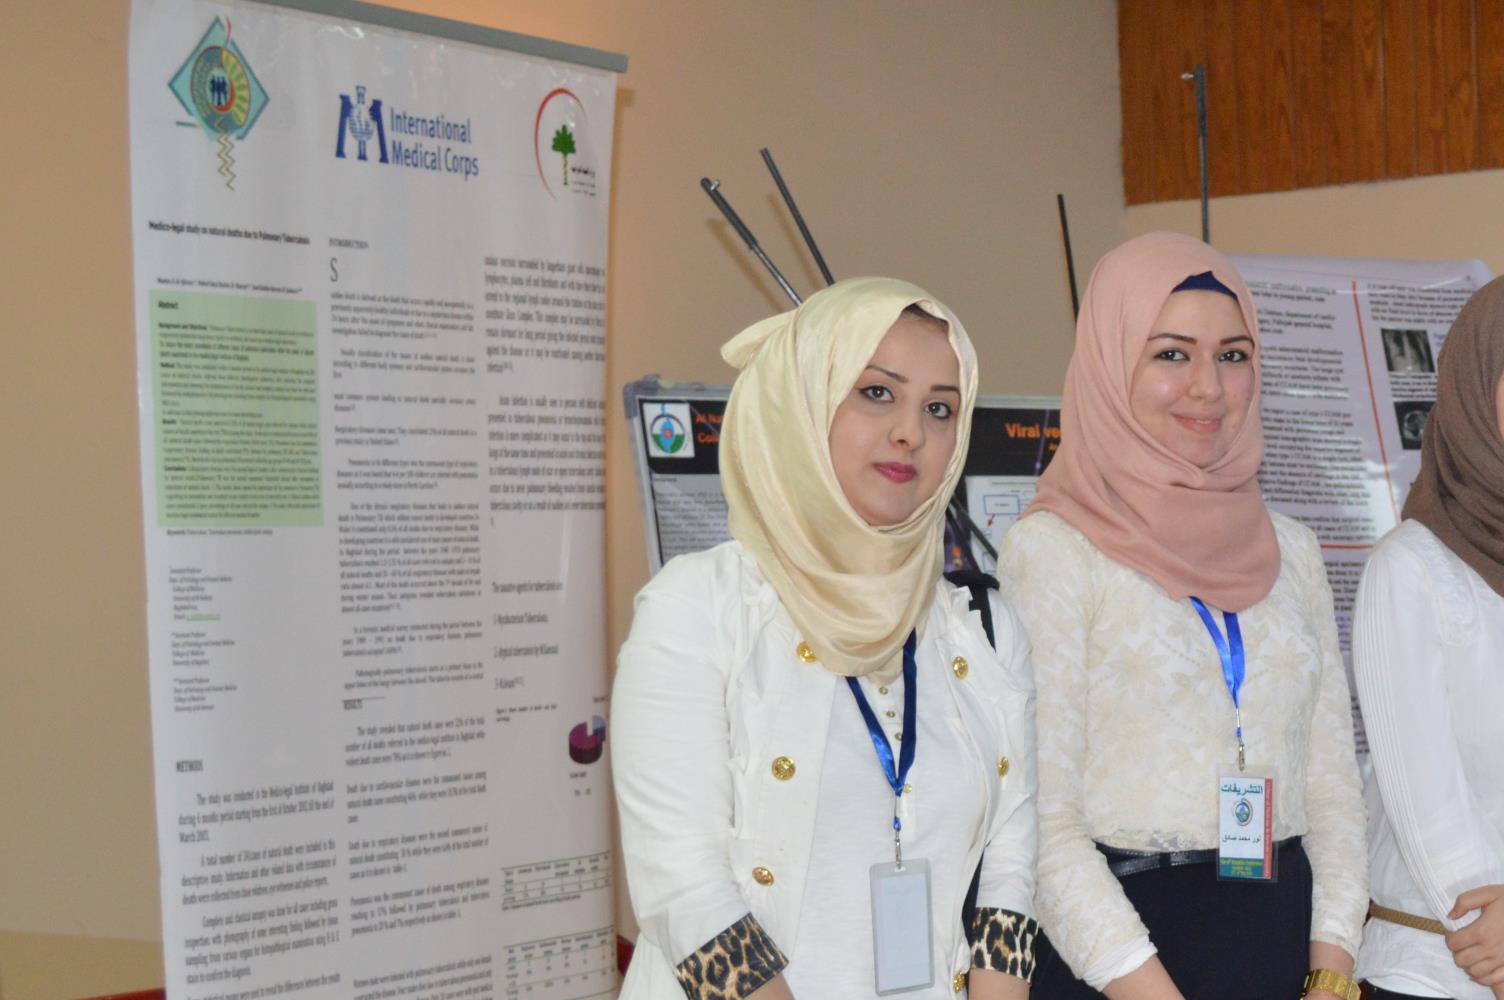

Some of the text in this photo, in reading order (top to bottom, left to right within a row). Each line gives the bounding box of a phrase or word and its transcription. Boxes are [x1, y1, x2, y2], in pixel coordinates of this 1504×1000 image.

[390, 107, 471, 144] International
[391, 140, 480, 182] Medical Corps
[330, 257, 339, 283] S
[1004, 422, 1041, 439] Viral
[1220, 783, 1264, 796] التشريفات
